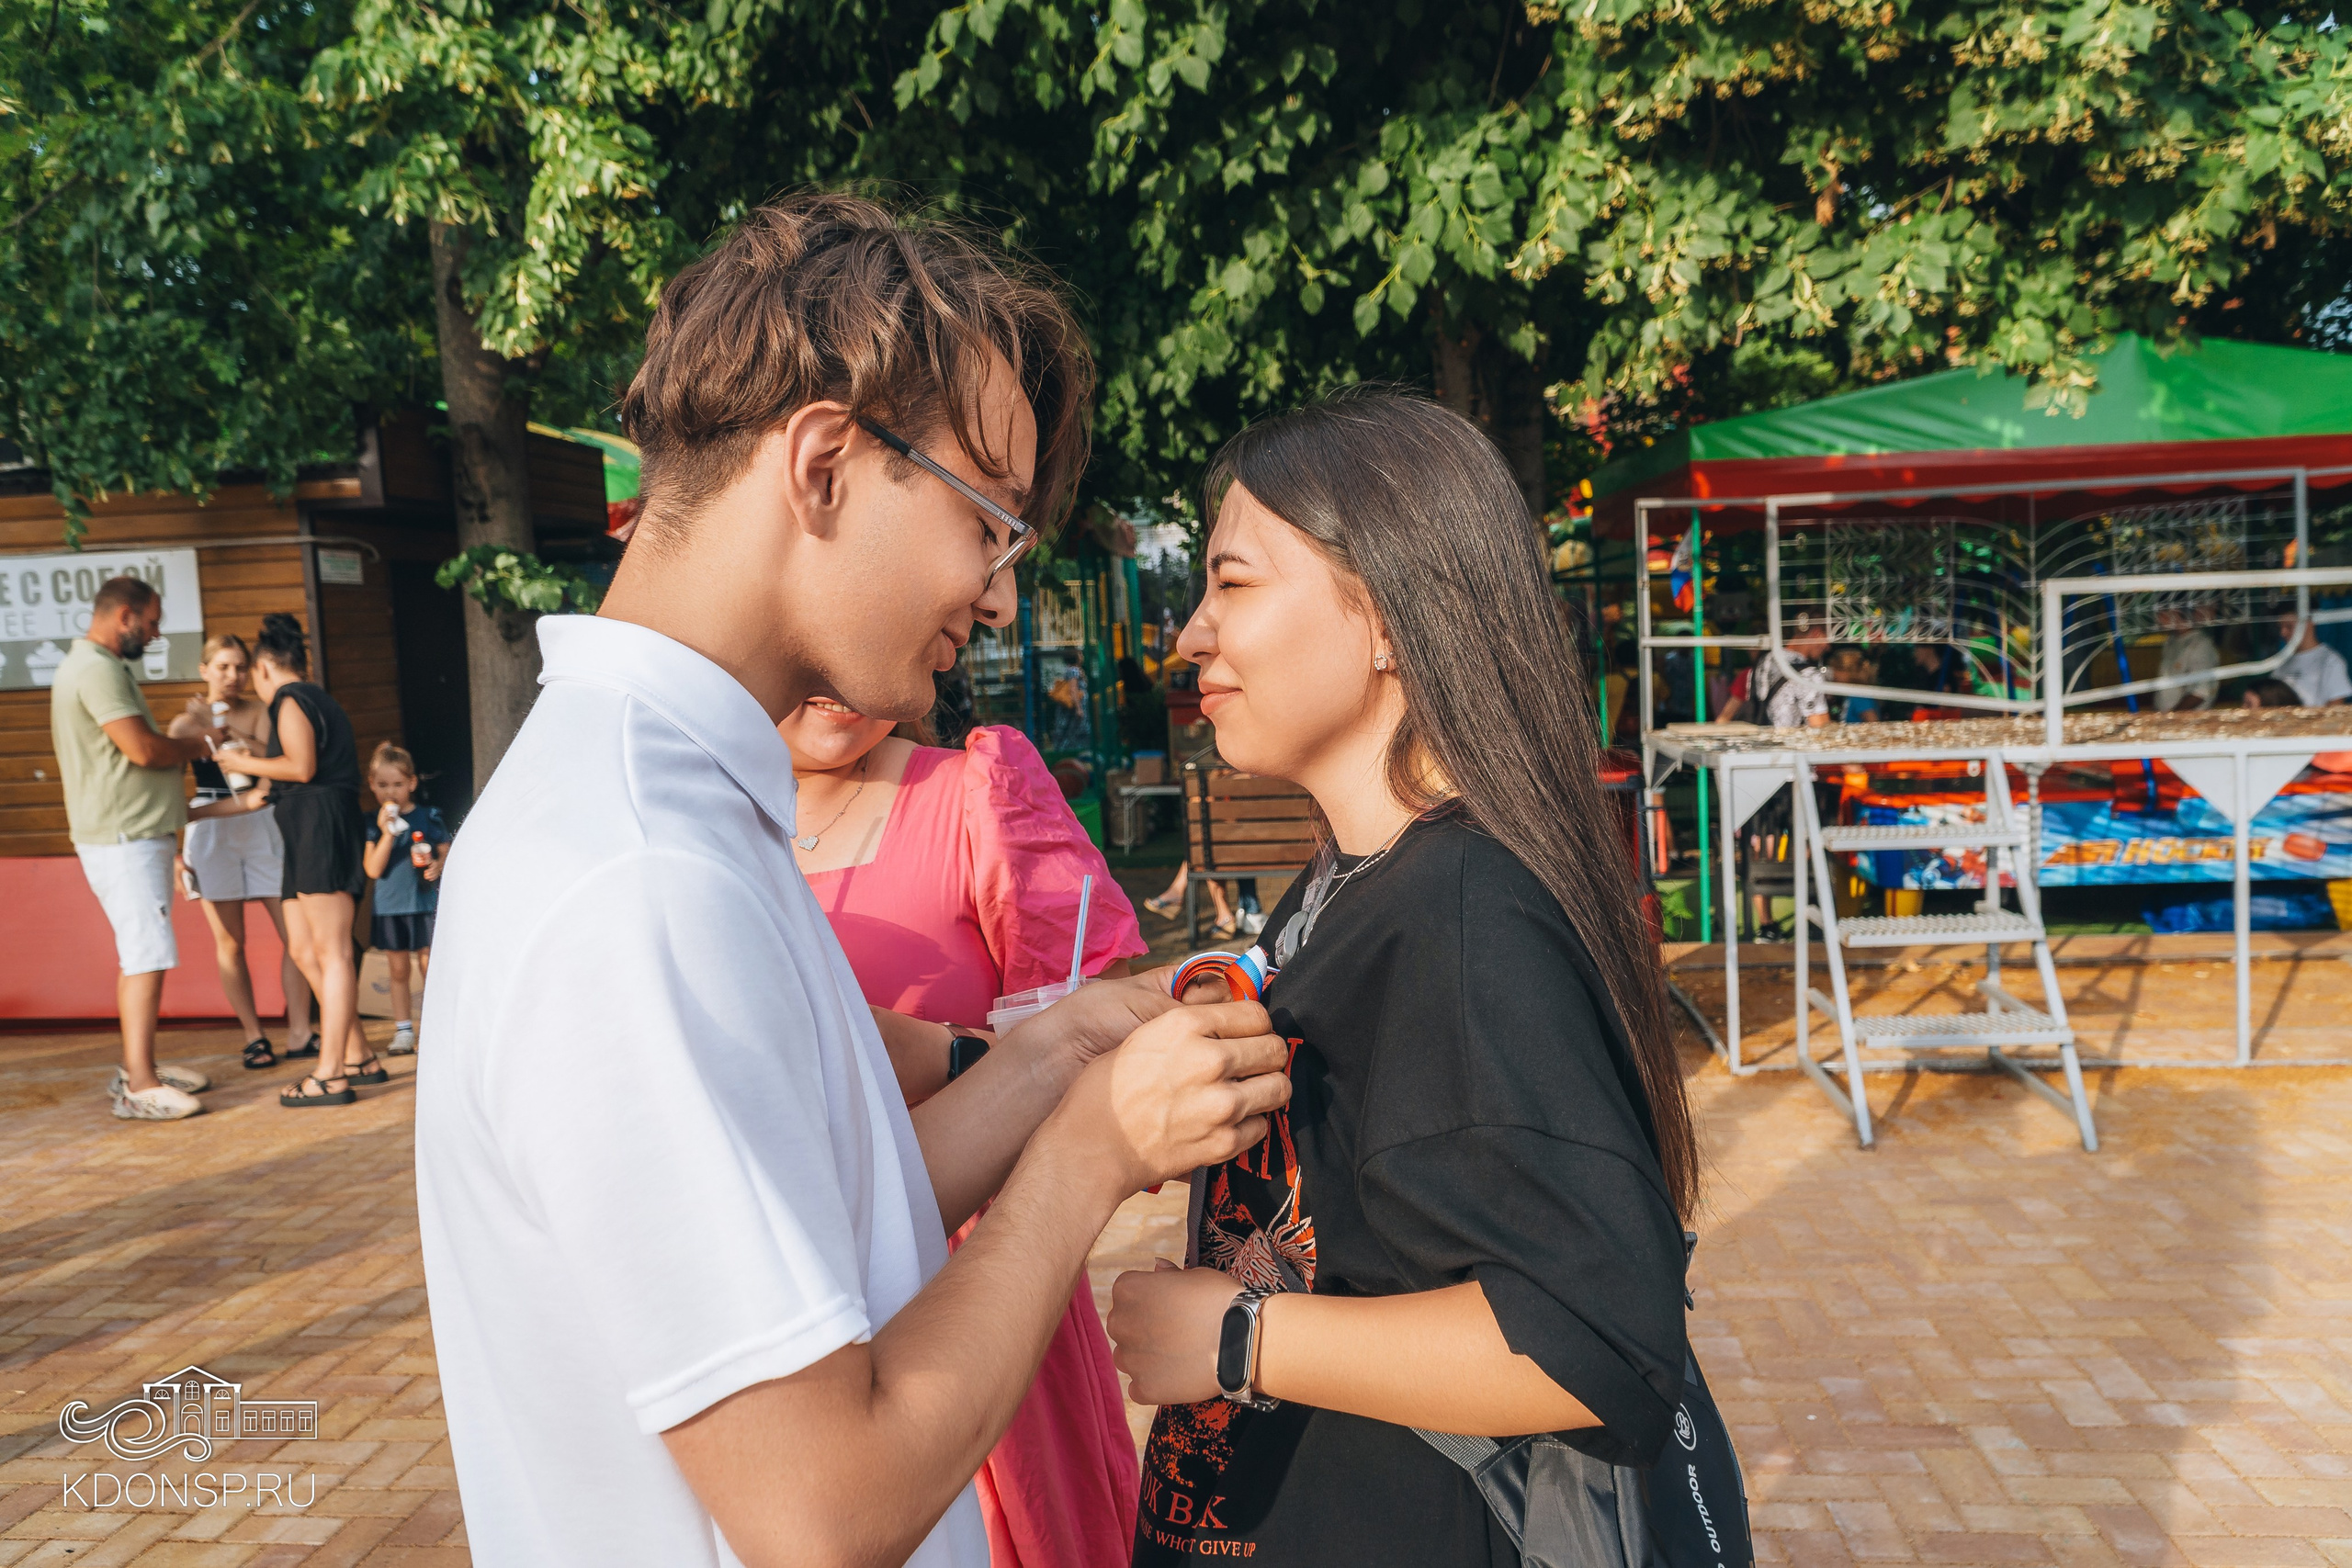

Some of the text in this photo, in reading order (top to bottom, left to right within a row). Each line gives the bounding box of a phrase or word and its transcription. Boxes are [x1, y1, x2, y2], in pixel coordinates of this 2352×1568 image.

[51, 556, 165, 604] СОЙ
[1688, 1463, 1722, 1553] OUTDOOR
[1199, 1540, 1241, 1557] GIVE
[1243, 1542, 1256, 1557] UP
